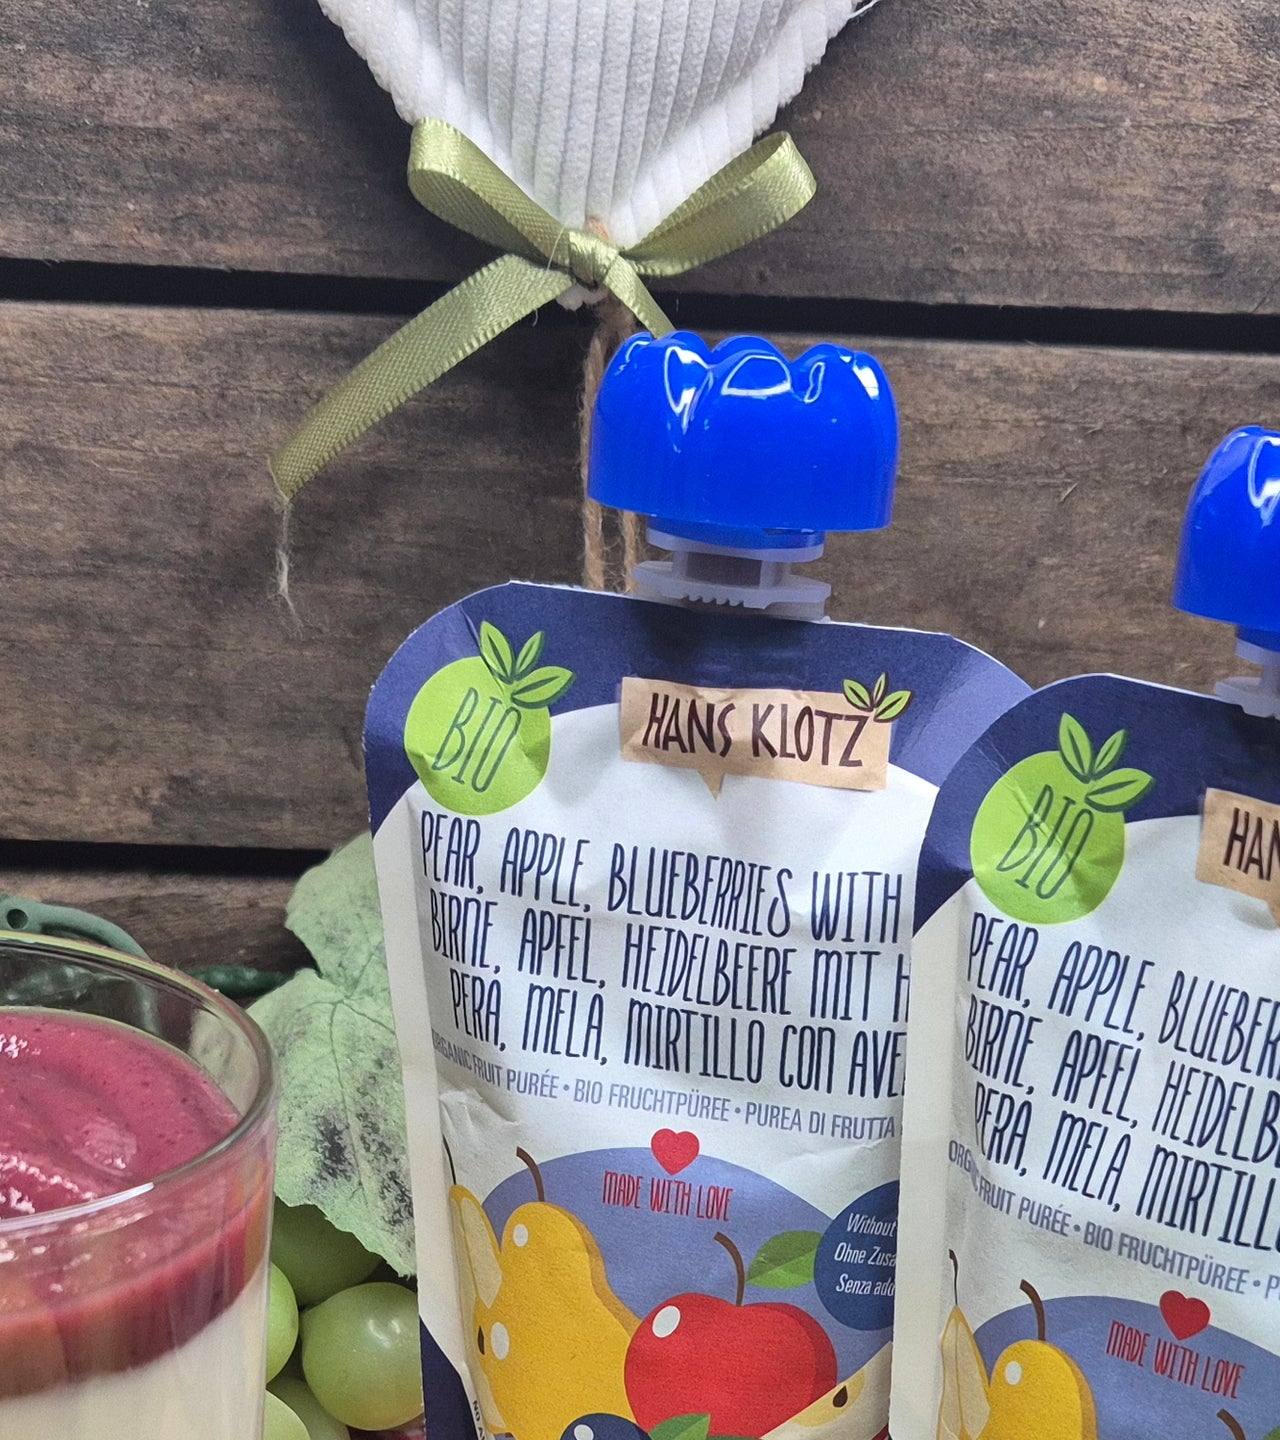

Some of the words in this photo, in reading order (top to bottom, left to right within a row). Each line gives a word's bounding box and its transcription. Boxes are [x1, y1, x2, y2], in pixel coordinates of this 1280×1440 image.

[432, 687, 522, 793] BIO
[641, 692, 736, 758] HANS
[751, 703, 870, 767] KLOTZ
[421, 810, 484, 894] PEAR,
[500, 827, 591, 913] APPLE,
[607, 843, 794, 938] BLUEBERRIES
[810, 871, 903, 944] WITH
[995, 784, 1095, 899] BIO
[430, 888, 502, 974] BIRNE,
[517, 907, 606, 989] APFEL,
[621, 923, 798, 1016] HEIDELBEERE
[809, 948, 882, 1022] MIT
[967, 911, 1040, 1009] PEAR,
[1046, 940, 1156, 1041] APPLE,
[450, 968, 507, 1052] PERA,
[521, 983, 608, 1066] MELA,
[623, 998, 766, 1084] MIRTILLO
[779, 1024, 836, 1094] CON
[847, 1030, 908, 1100] AVE
[965, 994, 1044, 1096] BIRNE,
[1051, 1030, 1142, 1129] APFEL,
[472, 1054, 503, 1088] FRUIT
[506, 1068, 560, 1099] PURÉE
[573, 1078, 604, 1105] BIO
[608, 1083, 732, 1122] FRUCHTPÜREE
[744, 1101, 802, 1132] PUREA
[808, 1110, 826, 1135] DI
[830, 1114, 896, 1141] FRUTTA
[974, 1081, 1033, 1177] PERA,
[1042, 1110, 1132, 1213] MELA,
[602, 1170, 644, 1209] MADE
[649, 1176, 693, 1217] WITH
[697, 1184, 735, 1222] LOVE
[846, 1212, 897, 1238] Without
[978, 1175, 1017, 1215] FRUIT
[1017, 1196, 1072, 1238] PURÉE
[1083, 1221, 1114, 1252] BIO
[1118, 1232, 1250, 1295] FRUCHTPÜREE
[834, 1241, 867, 1265] Ohne
[835, 1272, 873, 1295] Senza
[472, 1400, 481, 1422] NO
[1105, 1320, 1151, 1368] MADE
[1153, 1338, 1200, 1385] WITH
[1201, 1356, 1246, 1399] LOVE
